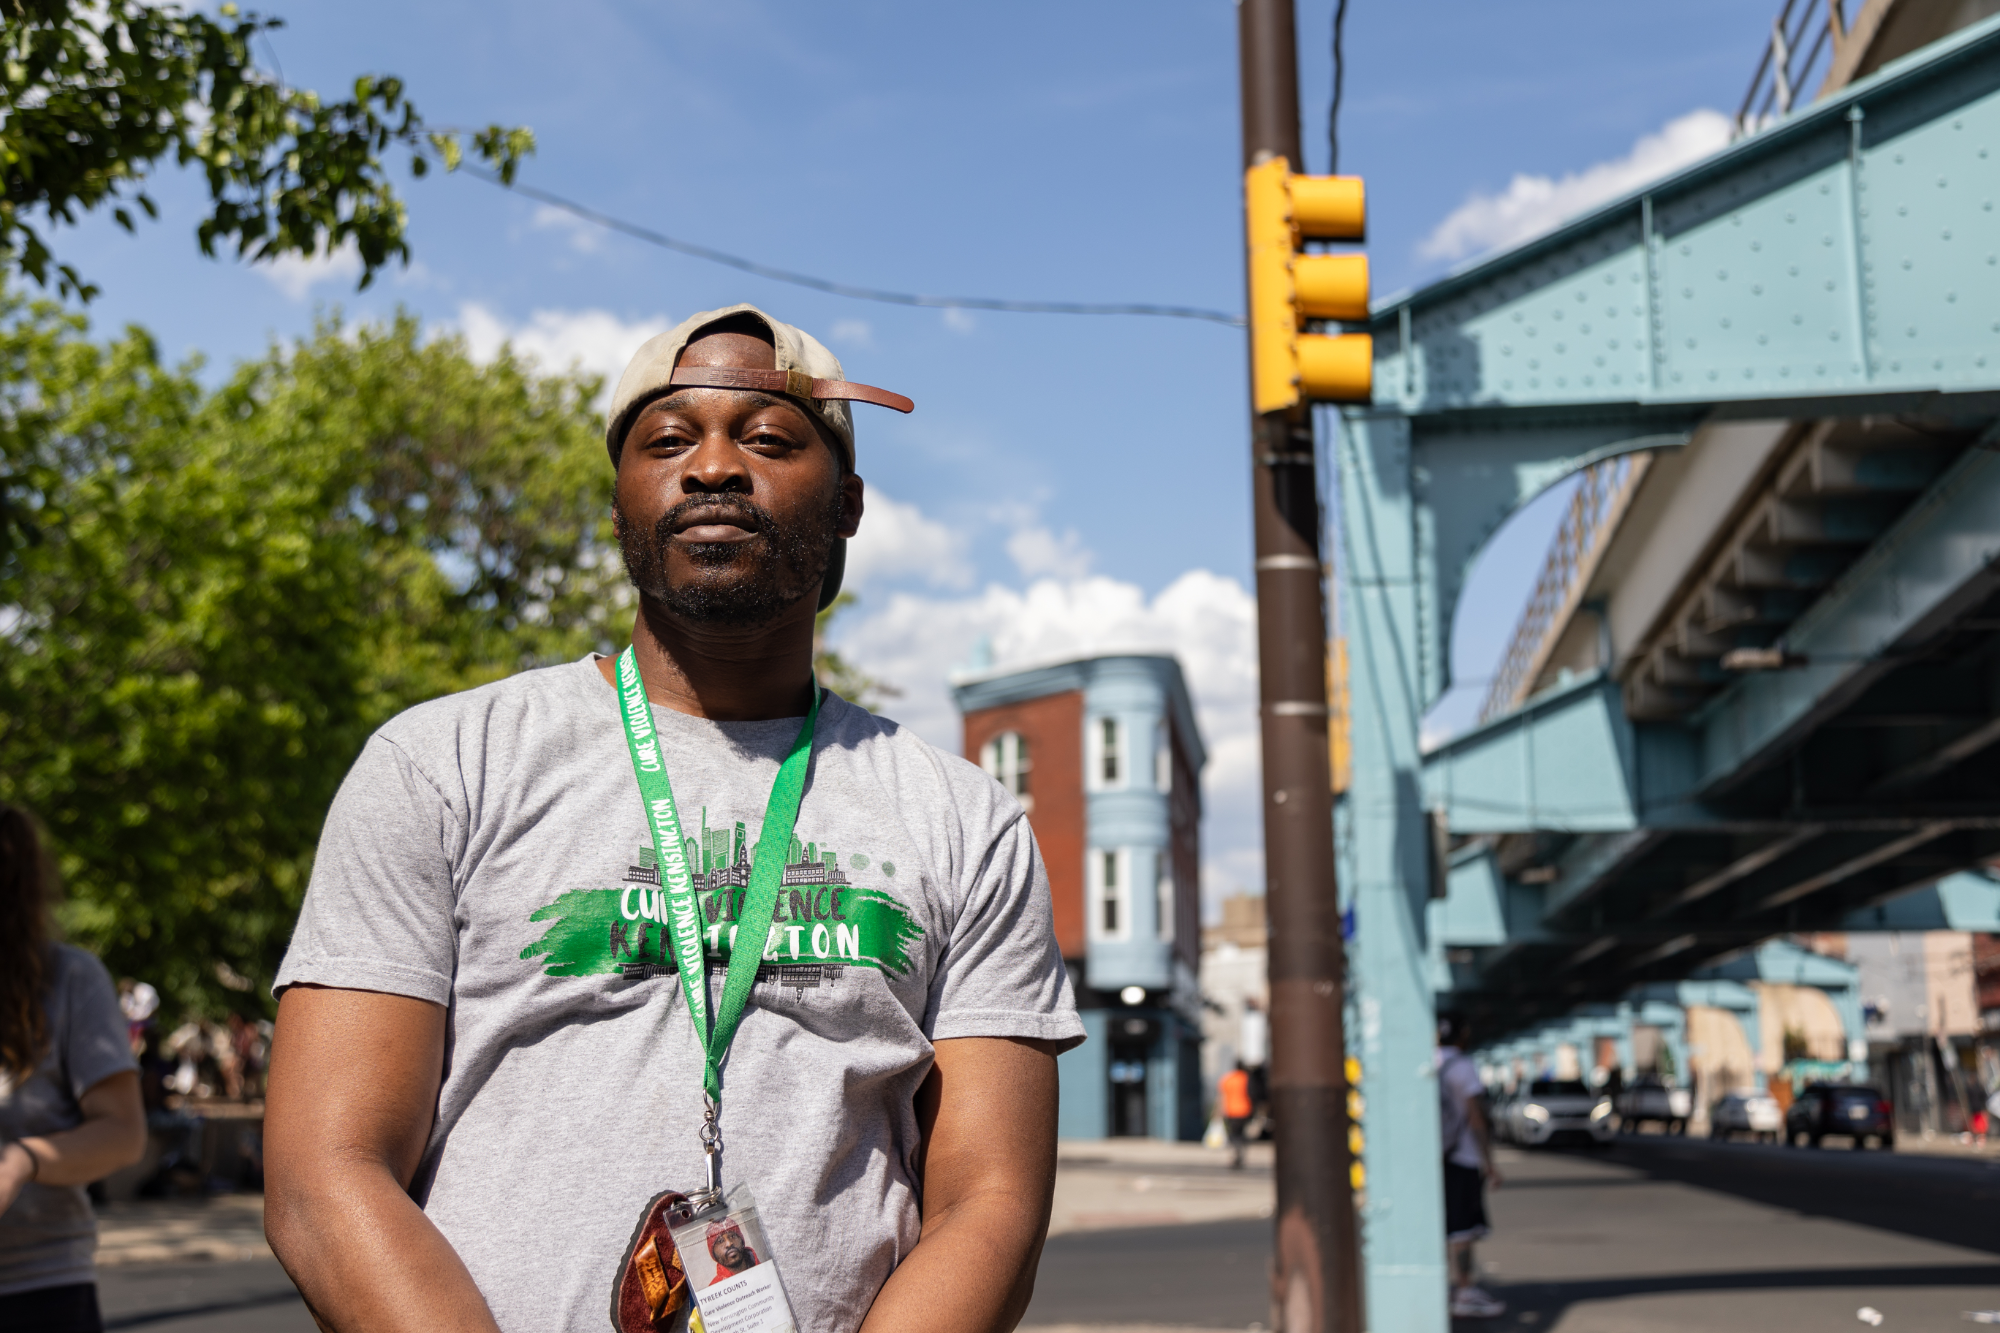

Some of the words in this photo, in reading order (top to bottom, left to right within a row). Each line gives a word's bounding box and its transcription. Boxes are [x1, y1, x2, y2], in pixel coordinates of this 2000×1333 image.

[624, 683, 652, 740] VIOLENCE
[636, 738, 660, 772] CURE
[651, 798, 690, 895] KENSINGTON
[621, 884, 669, 926] CU
[704, 886, 847, 924] VIENCE
[671, 895, 702, 976] VIOLENCE
[689, 973, 705, 1018] CURE
[699, 1290, 722, 1306] TYREEK
[723, 1279, 748, 1296] COUNTS
[703, 1309, 716, 1317] Cure
[715, 1300, 736, 1312] Violence
[735, 1290, 757, 1303] Outreach
[755, 1283, 772, 1294] Worker
[707, 1319, 720, 1328] New
[720, 1307, 748, 1322] Kensington
[747, 1295, 775, 1311] Community
[744, 1305, 773, 1322] Corporation
